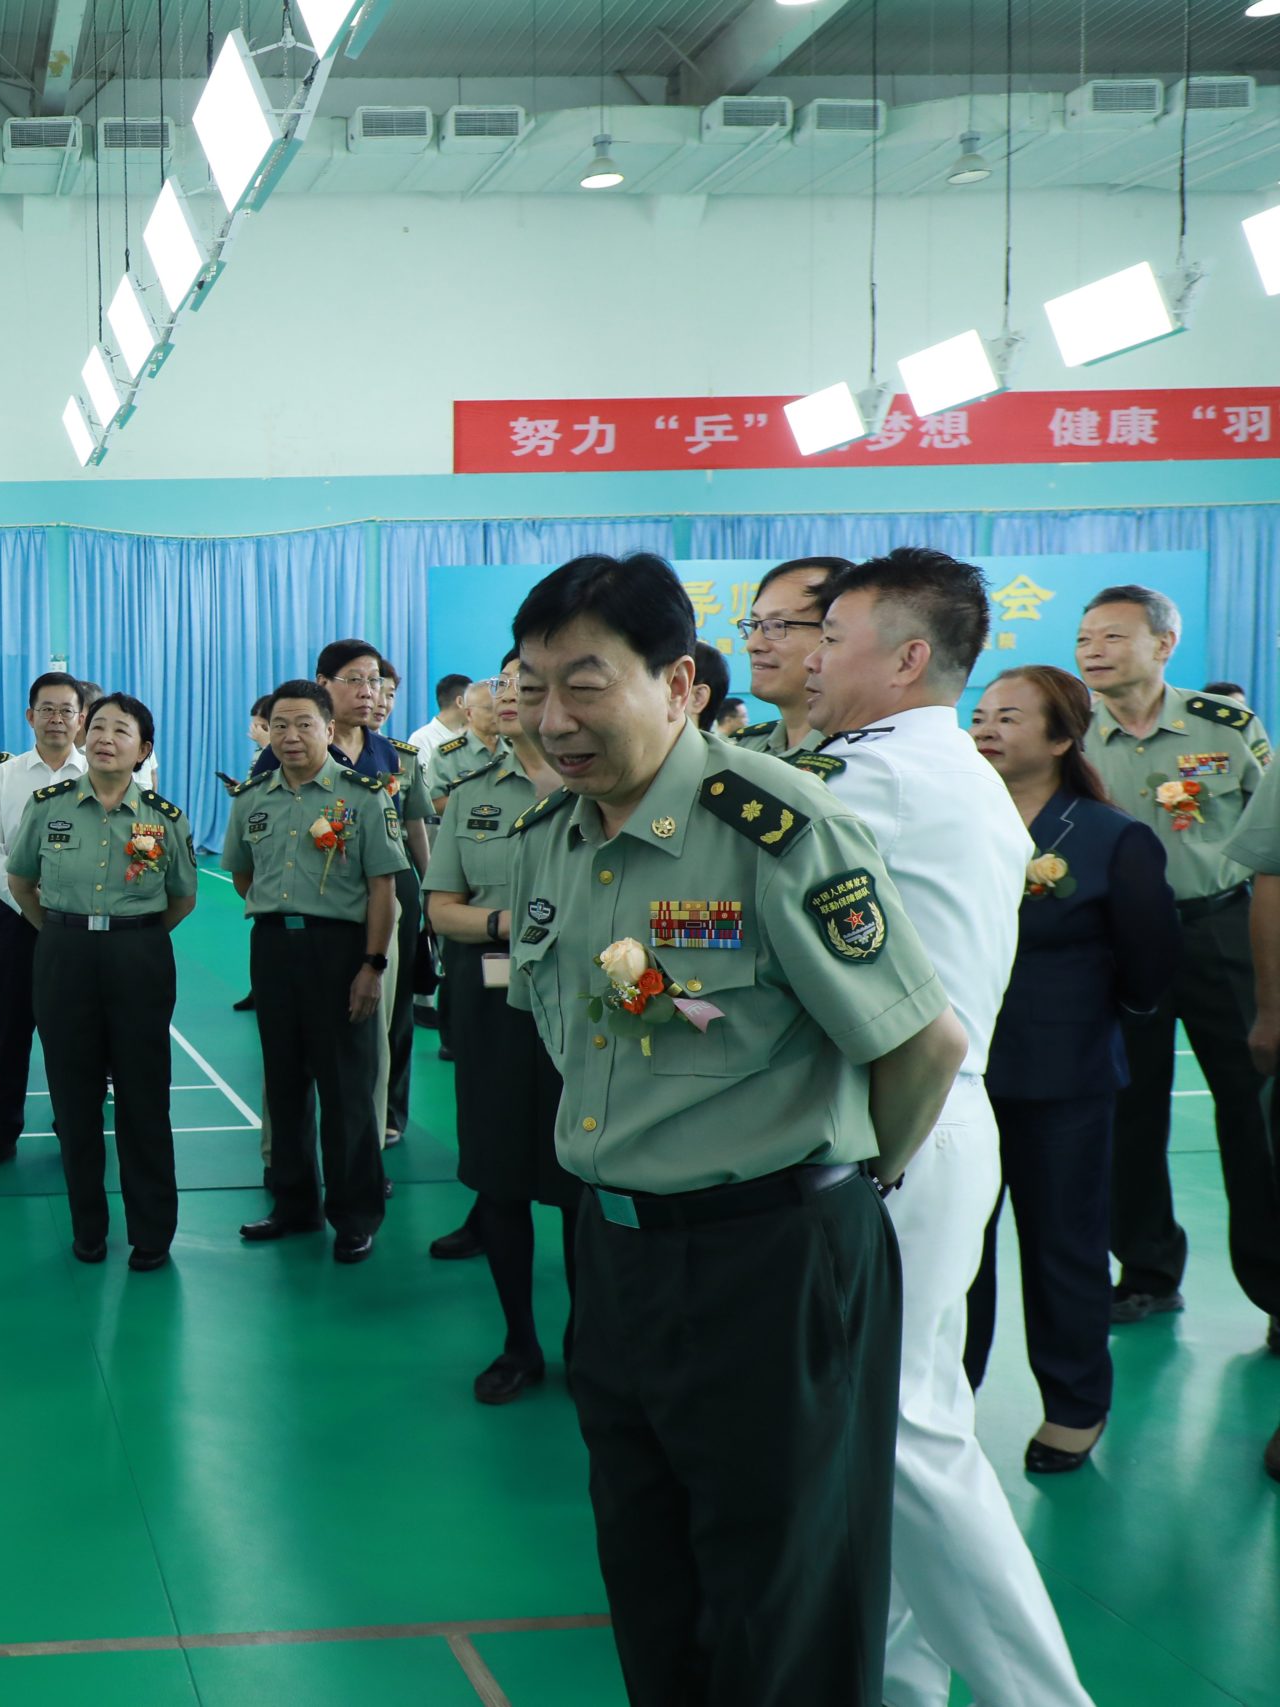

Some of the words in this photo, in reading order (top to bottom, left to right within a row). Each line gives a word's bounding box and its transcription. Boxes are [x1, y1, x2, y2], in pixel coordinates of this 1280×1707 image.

[508, 411, 973, 457] 努力“乒”梦想
[991, 574, 1056, 621] 会
[811, 875, 869, 906] 中国人民解放军
[820, 886, 871, 914] 联勤保障部队
